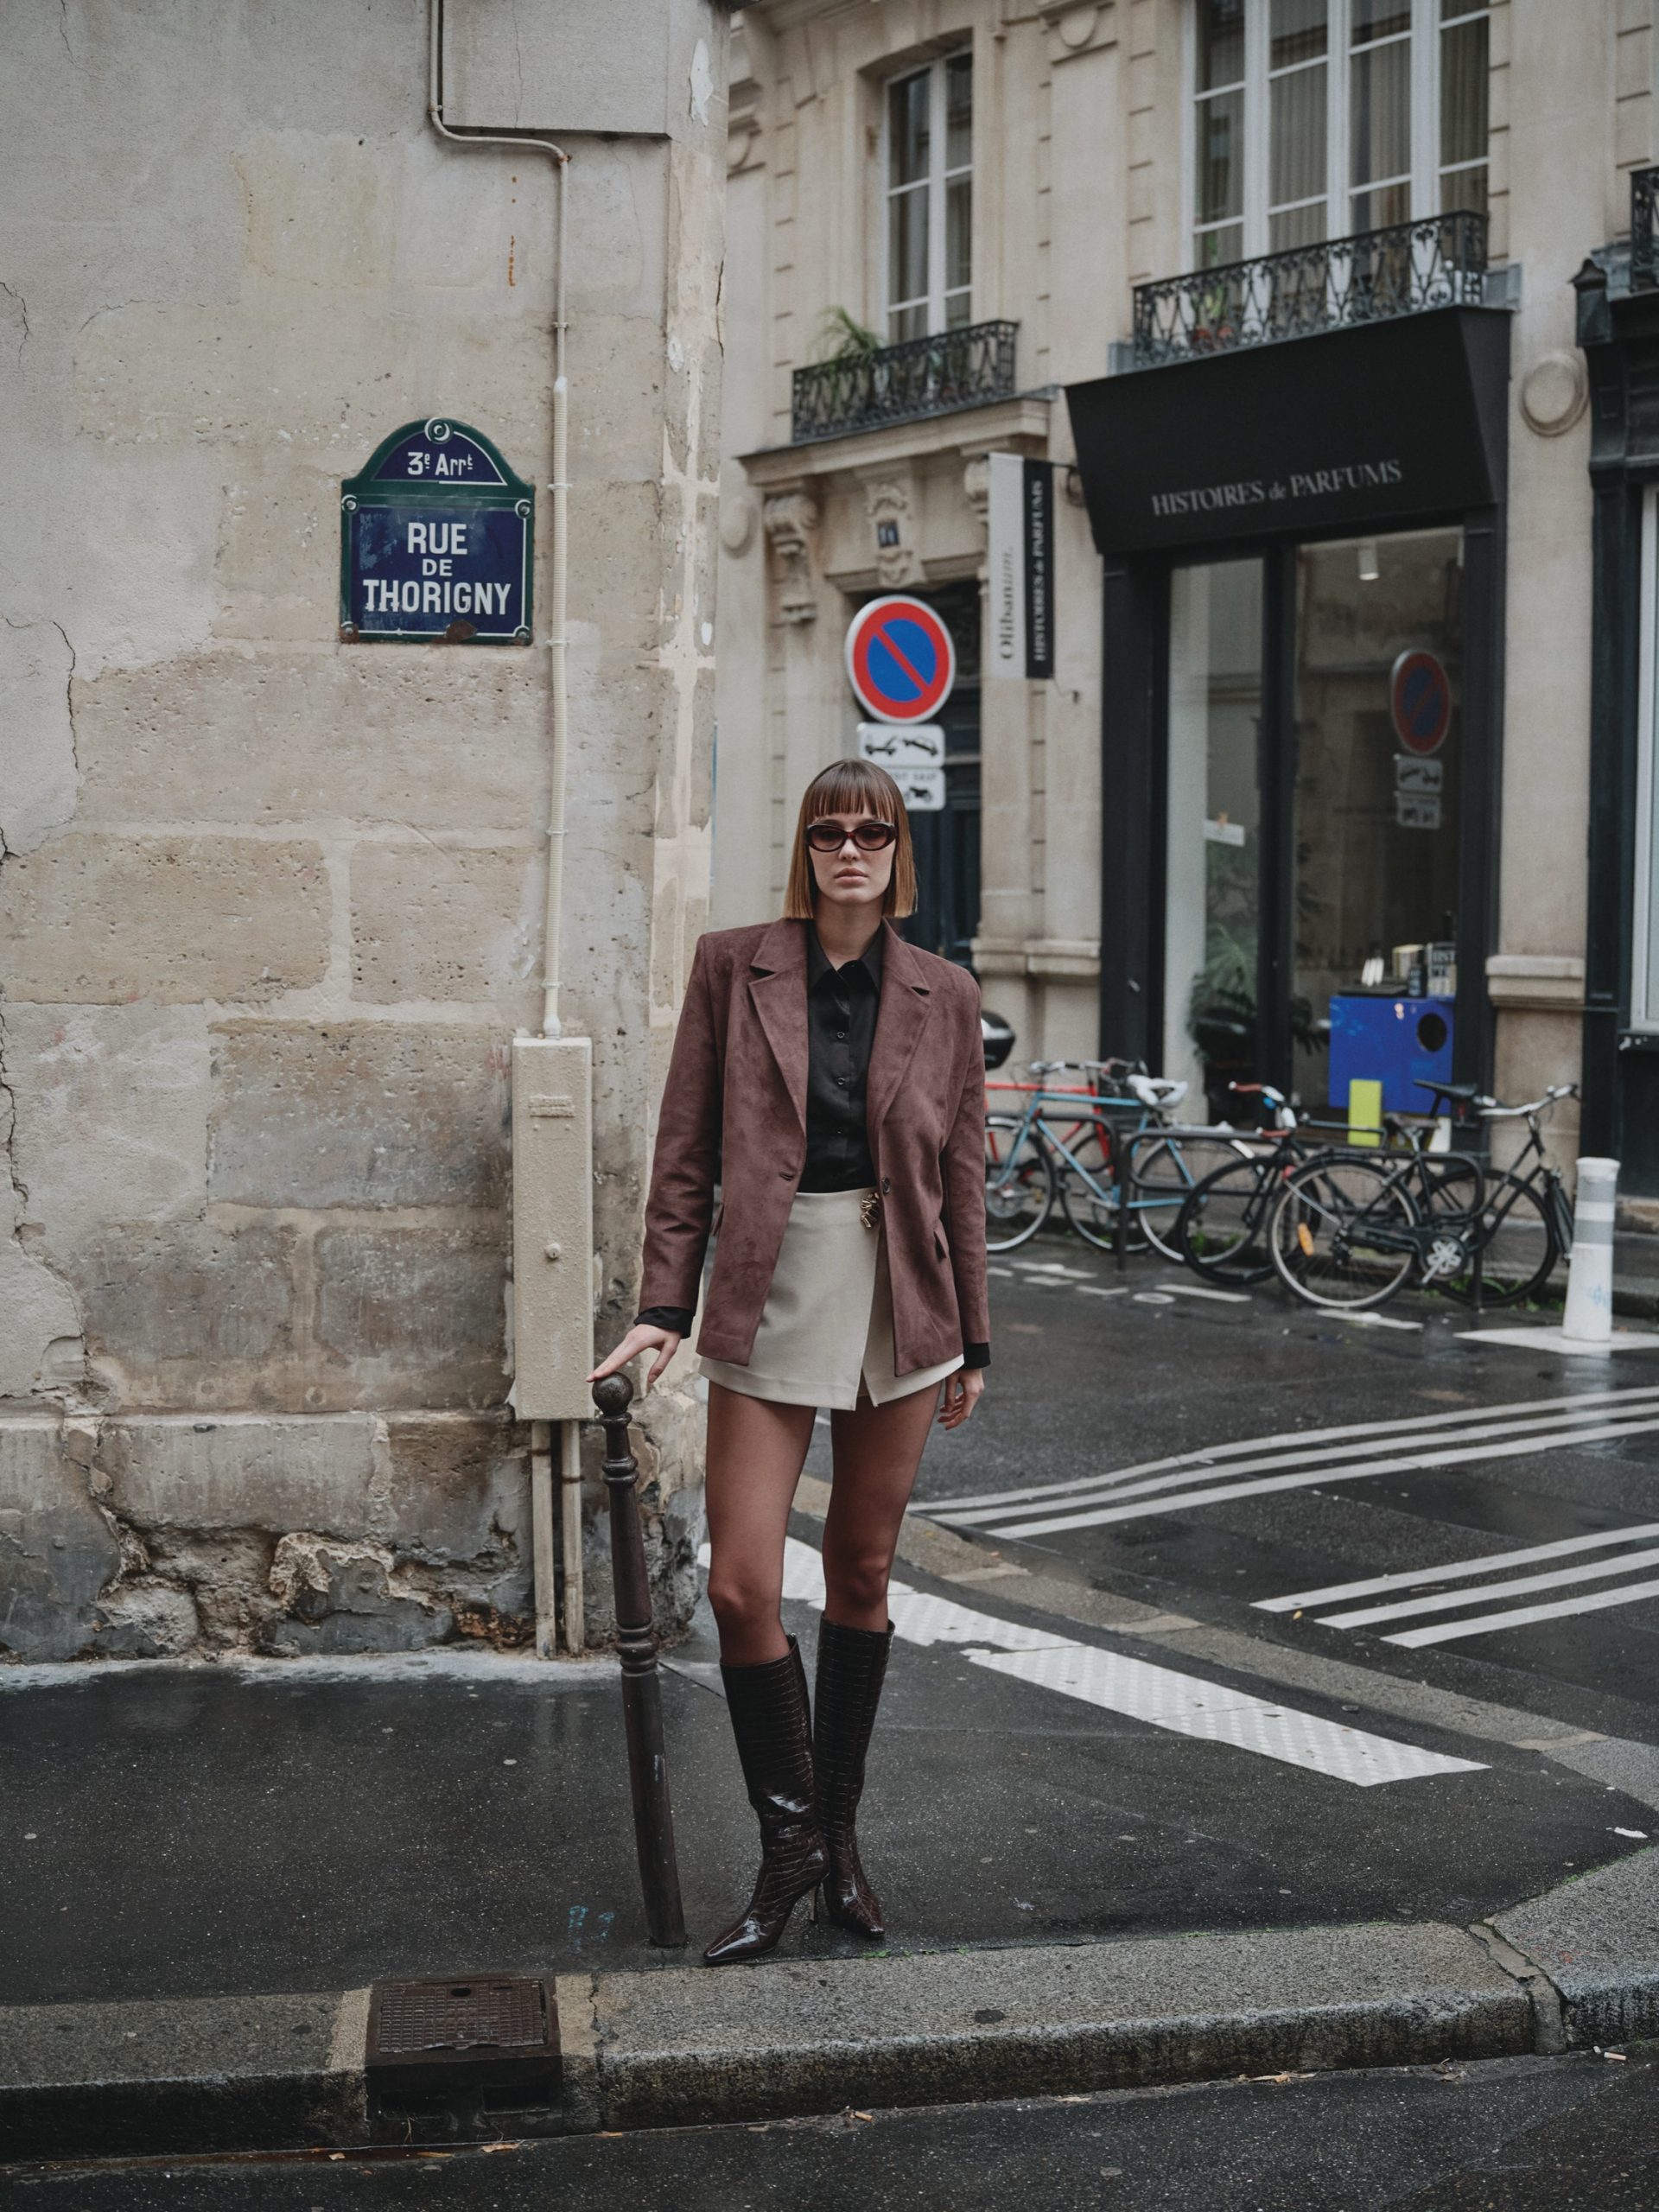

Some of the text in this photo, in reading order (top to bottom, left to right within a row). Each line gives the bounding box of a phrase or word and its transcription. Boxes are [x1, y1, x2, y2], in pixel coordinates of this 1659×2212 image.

[435, 452, 474, 476] Arrt
[1151, 459, 1402, 517] HISTOIRES de PARFUMS
[407, 522, 468, 556] RUE
[422, 558, 454, 577] DE
[362, 579, 512, 616] THORIGNY
